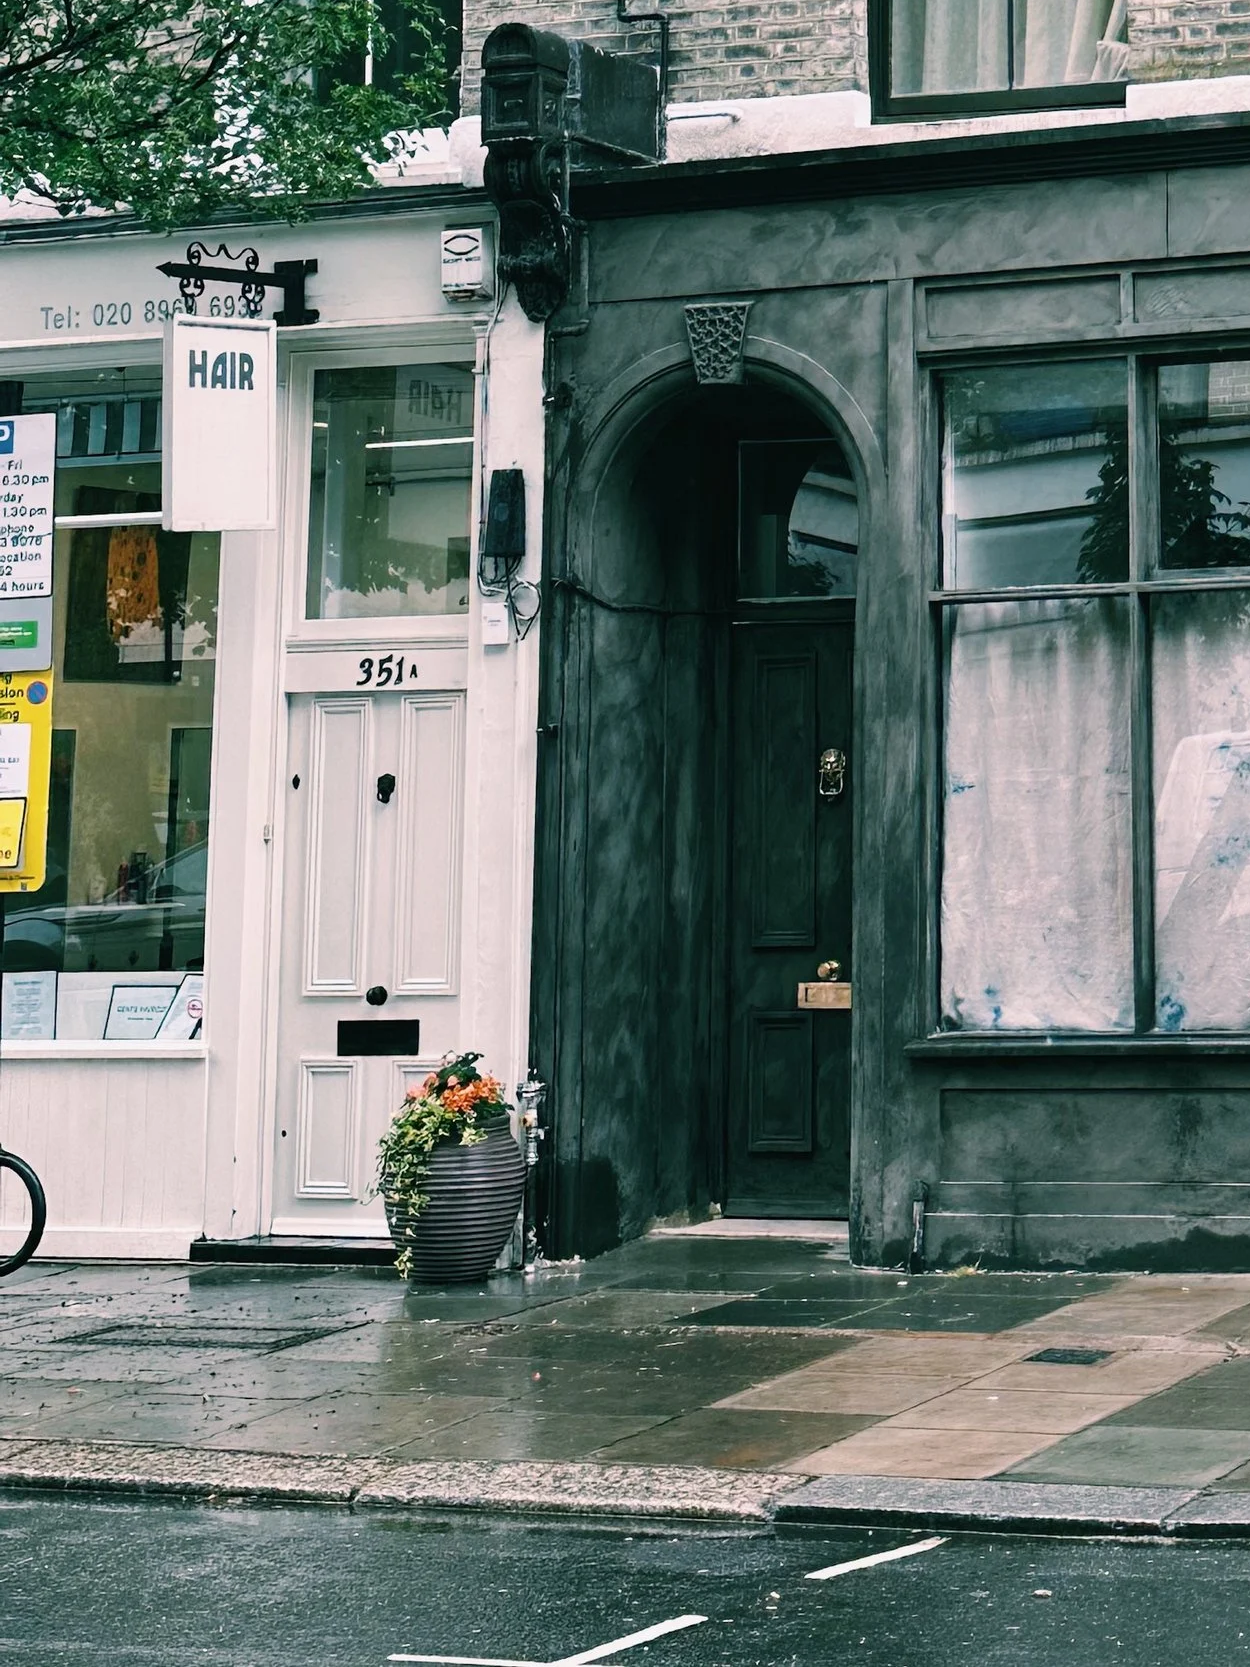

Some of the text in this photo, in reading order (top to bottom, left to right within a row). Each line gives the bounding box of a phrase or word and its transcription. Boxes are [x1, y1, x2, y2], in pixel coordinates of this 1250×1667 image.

[40, 305, 80, 330] Tel:
[93, 302, 132, 327] 020
[210, 295, 263, 319] 693
[188, 349, 254, 390] HAIR
